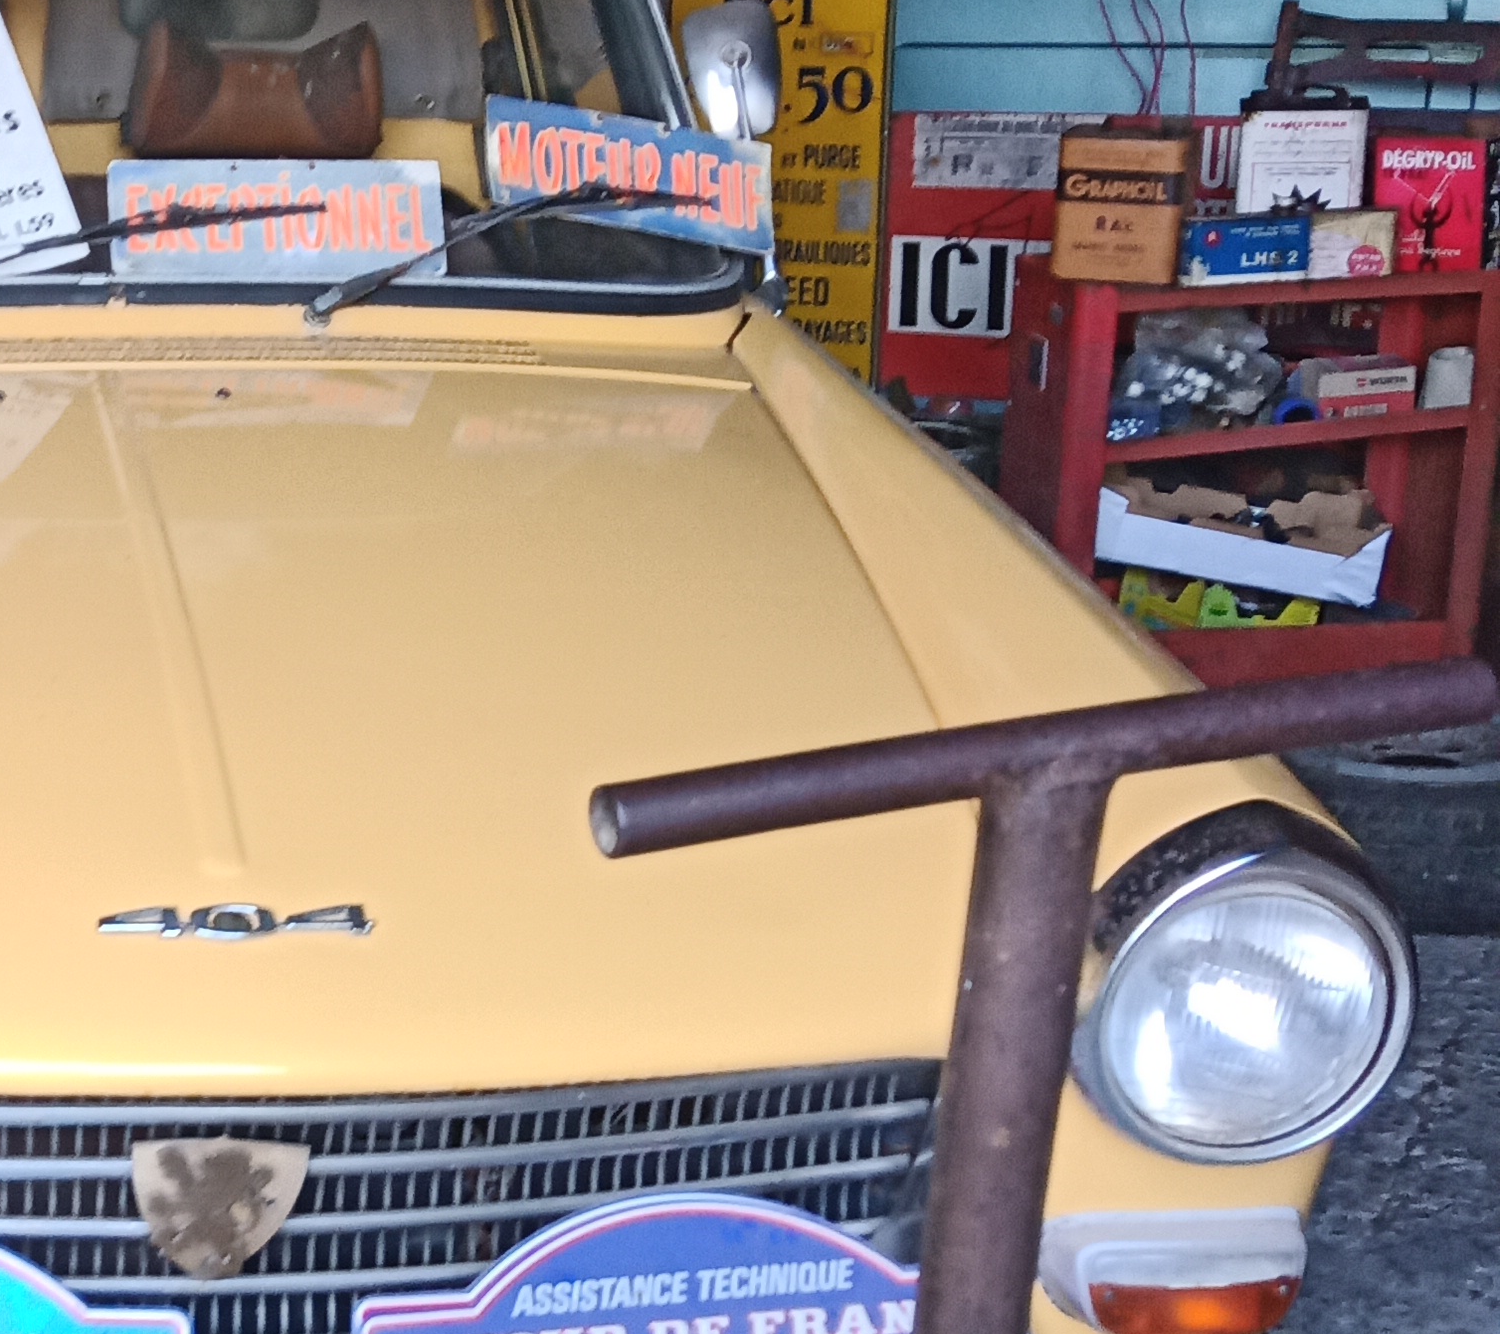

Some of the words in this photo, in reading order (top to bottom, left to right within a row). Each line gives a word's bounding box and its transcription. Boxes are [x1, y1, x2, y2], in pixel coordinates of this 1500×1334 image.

[498, 120, 661, 197] MOTEUR
[670, 150, 766, 233] NEUF
[803, 144, 862, 169] PURGE
[899, 240, 1009, 332] ICI
[510, 1269, 690, 1319] ASSISTANCE
[696, 1257, 856, 1303] TECHNIQUE
